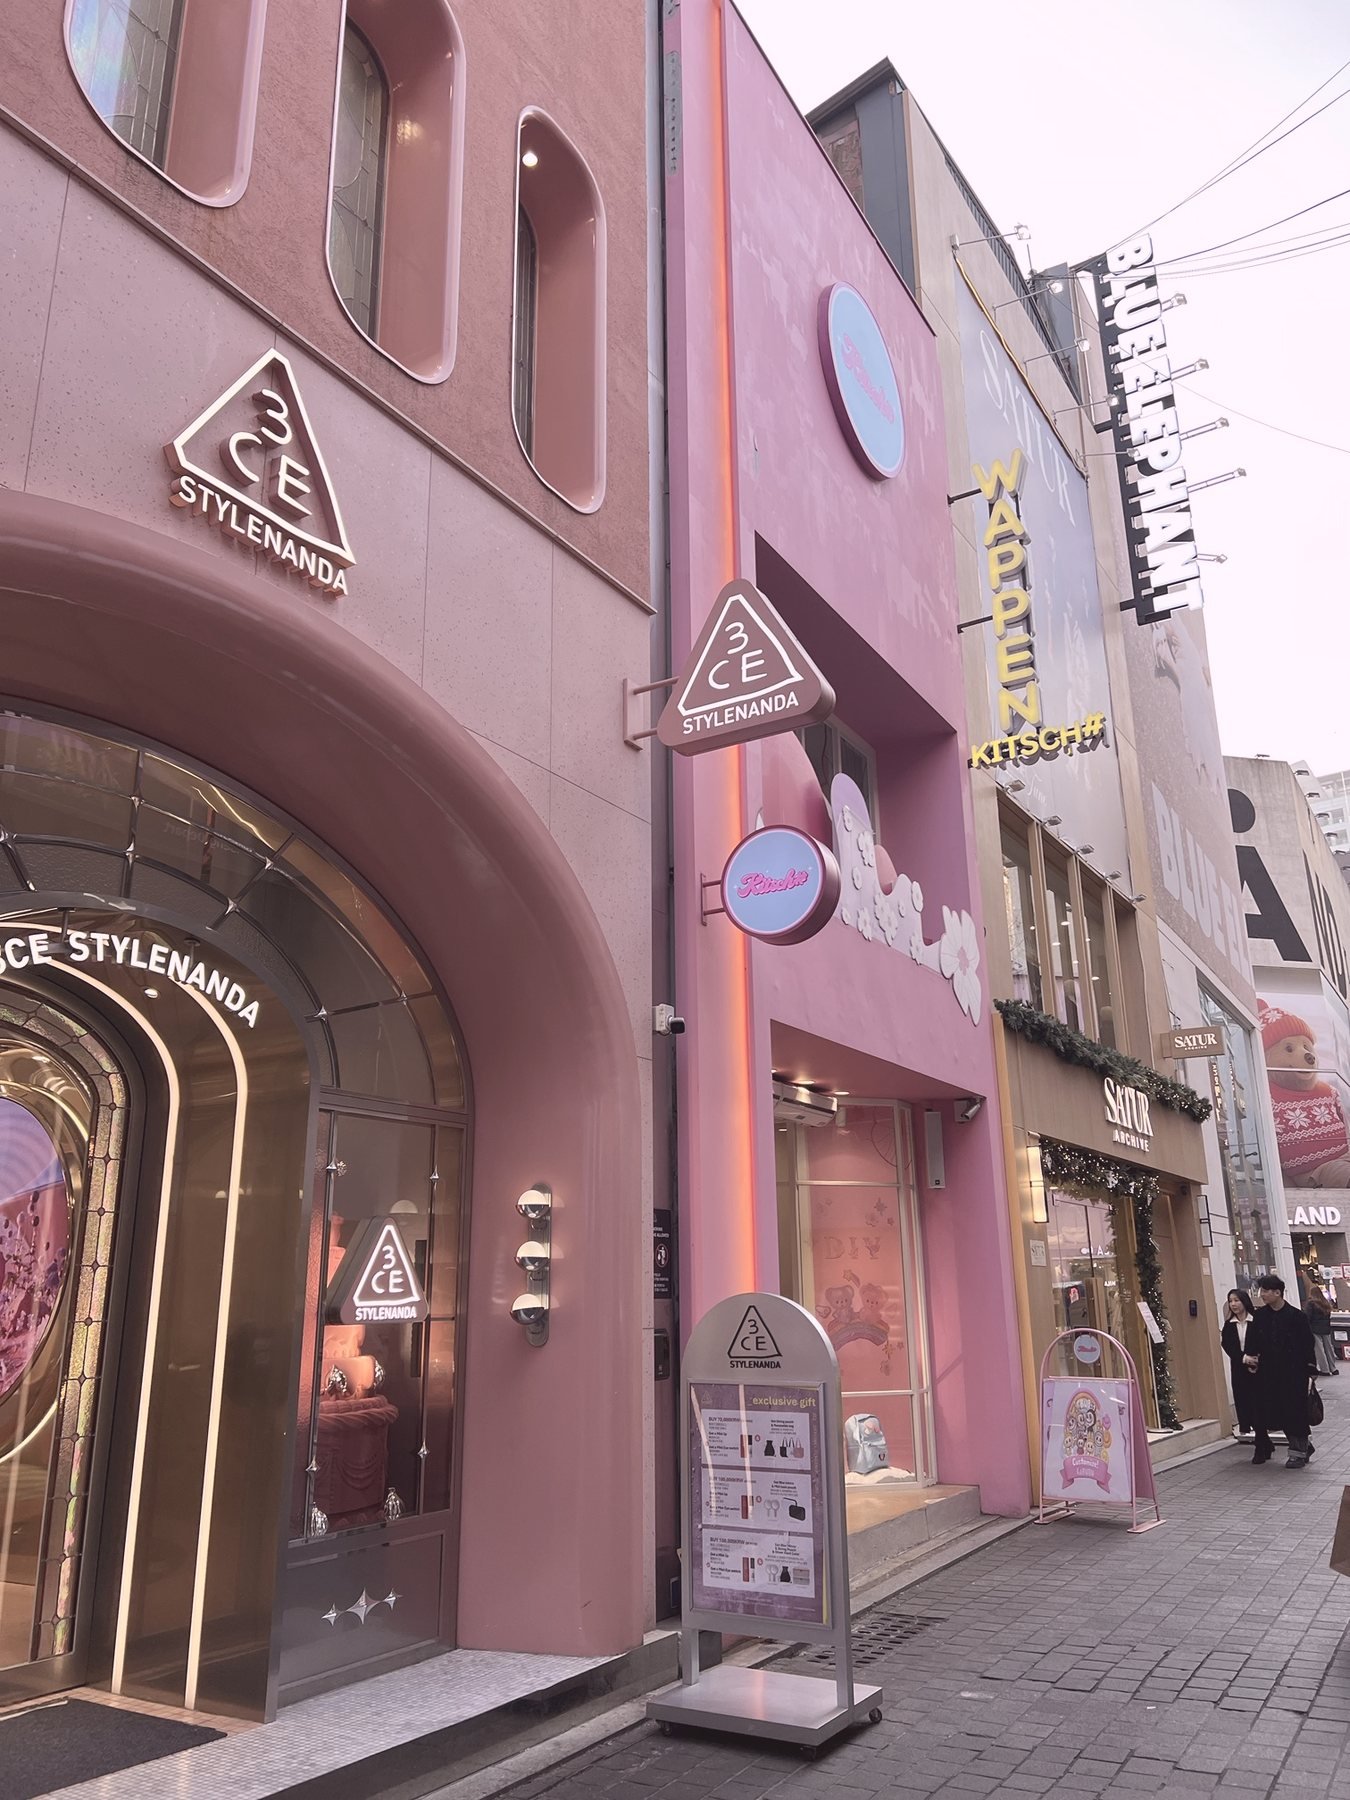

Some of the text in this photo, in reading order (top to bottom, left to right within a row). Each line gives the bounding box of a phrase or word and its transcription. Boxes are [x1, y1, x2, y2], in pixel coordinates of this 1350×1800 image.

[178, 475, 349, 596] STYLENANDA
[974, 448, 1042, 733] WAPPEN
[682, 691, 799, 735] STYLENANDA
[69, 931, 260, 1029] STYLENANDA
[1174, 1033, 1218, 1048] SATUR
[1104, 1076, 1154, 1137] SATUR
[1112, 1129, 1150, 1152] ARCHIVE
[355, 1306, 417, 1321] STYLENANDA
[729, 1360, 782, 1370] STYLENANDA
[752, 1396, 817, 1409] exclusive gift
